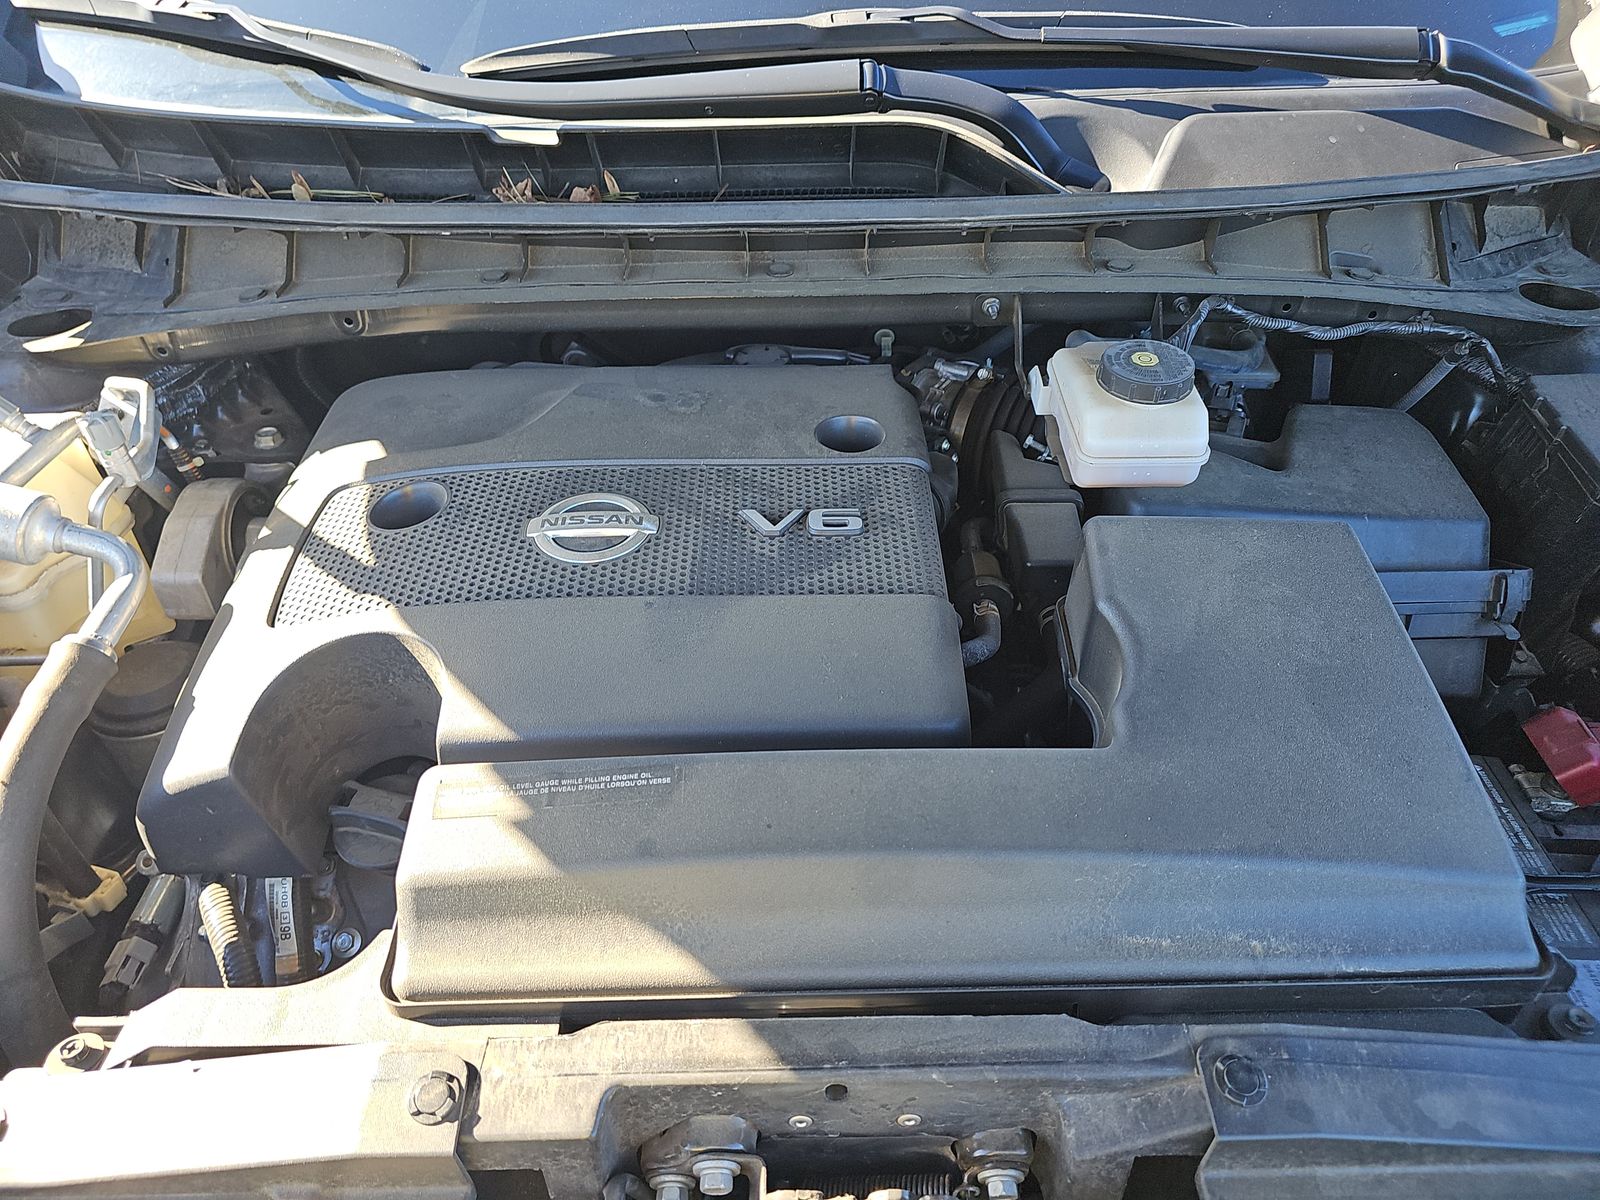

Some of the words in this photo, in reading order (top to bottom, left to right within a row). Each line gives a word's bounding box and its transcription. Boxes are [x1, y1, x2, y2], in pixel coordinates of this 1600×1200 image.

[540, 514, 644, 529] NISSAN
[737, 508, 863, 537] V6
[498, 784, 510, 792] OIL
[512, 782, 534, 790] LEVEL
[535, 779, 559, 788] GAUGE
[561, 777, 583, 785] WHILE
[584, 775, 611, 784] FILLING
[612, 773, 639, 781] ENGINE
[515, 788, 538, 797] JAUGE
[550, 784, 577, 793] NIVEAU
[578, 781, 605, 791] D'HUILE
[607, 779, 647, 789] LORSQU'ON
[648, 776, 671, 785] VERSE
[280, 925, 292, 941] 9B
